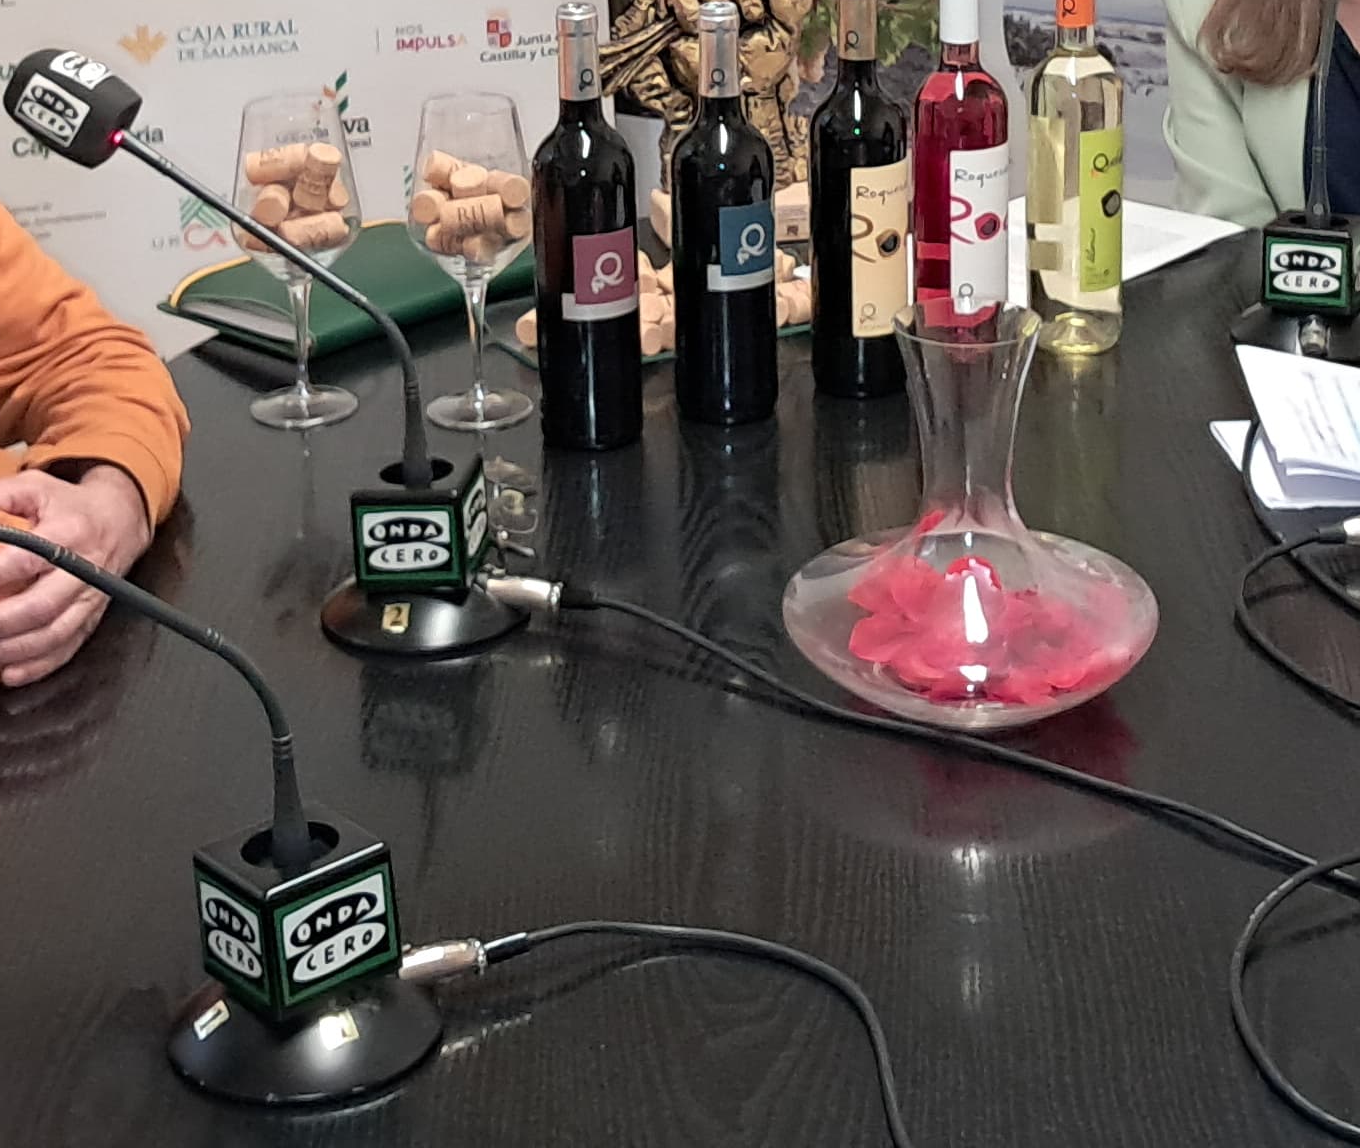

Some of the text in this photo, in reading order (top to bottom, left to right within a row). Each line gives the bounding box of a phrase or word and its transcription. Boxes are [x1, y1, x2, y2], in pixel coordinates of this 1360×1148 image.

[1279, 253, 1332, 268] ONDA
[1283, 275, 1331, 288] CERO
[373, 522, 439, 538] ONDA
[380, 547, 439, 563] CERO
[207, 899, 254, 942] ONDA
[297, 896, 372, 942] ONDA
[215, 934, 256, 972] CERO
[306, 928, 374, 971] CERO
